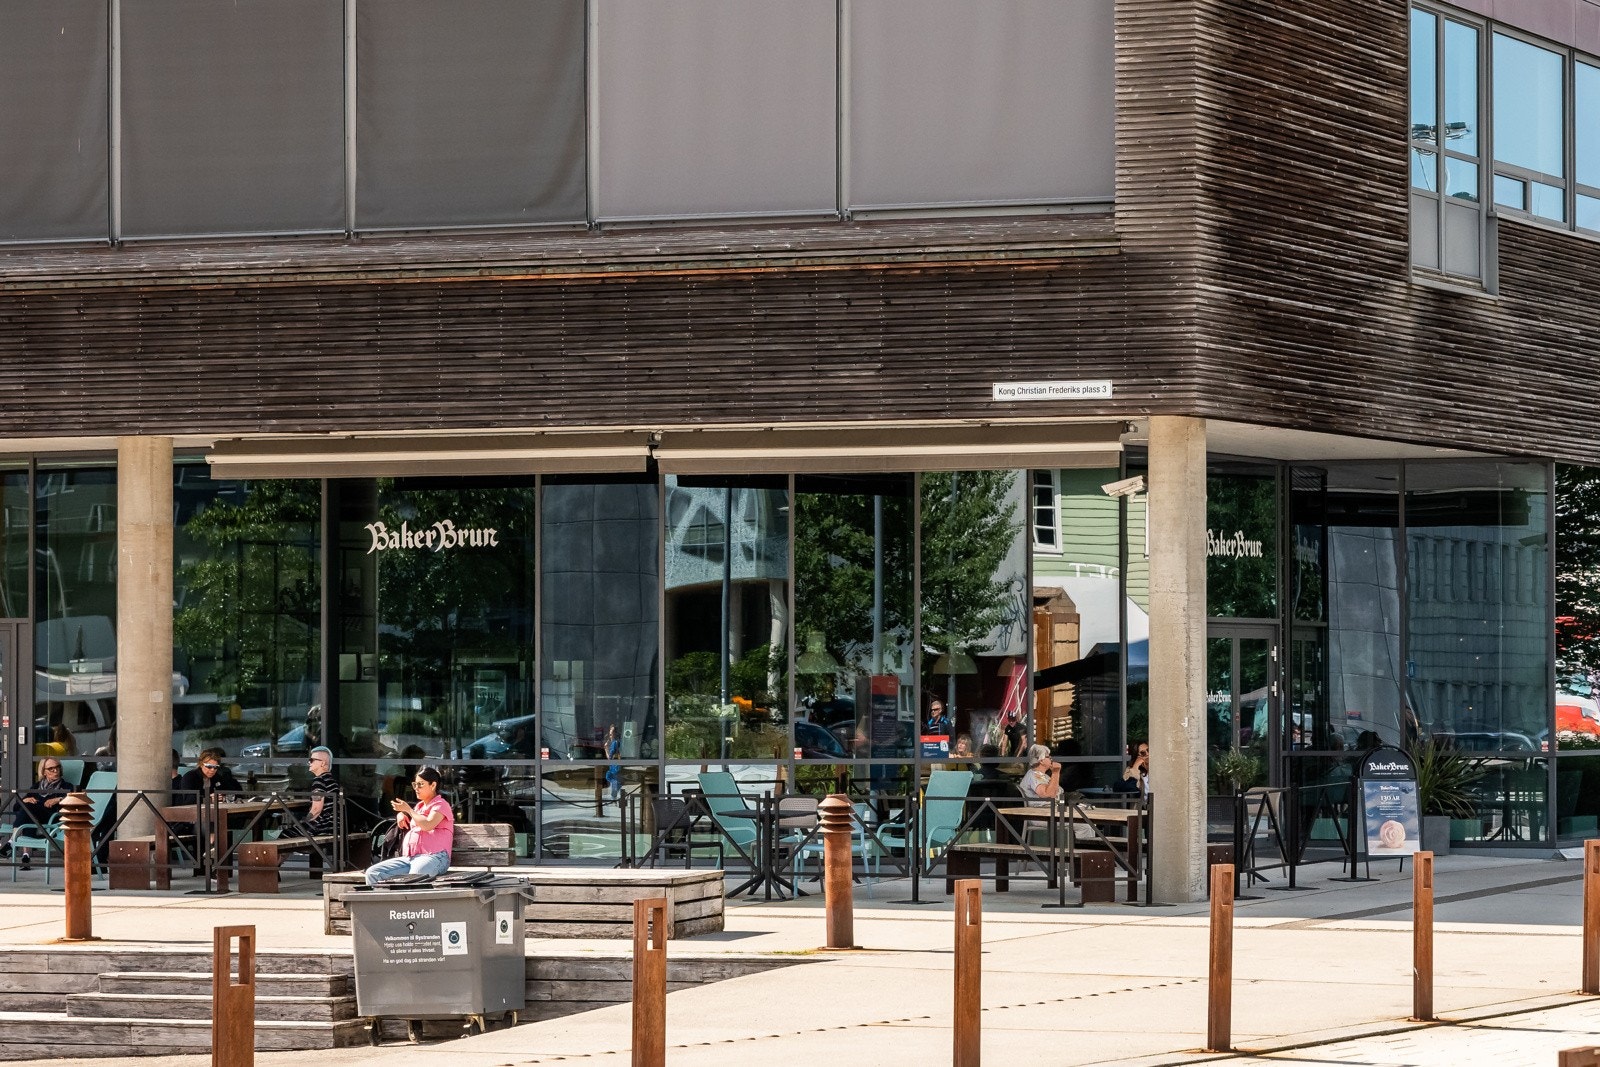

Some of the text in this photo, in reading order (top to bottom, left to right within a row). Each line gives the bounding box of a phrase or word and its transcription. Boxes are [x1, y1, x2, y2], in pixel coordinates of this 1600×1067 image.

[998, 385, 1107, 396] Kong Christian Frederiks plass 3
[1369, 762, 1409, 771] BakerBrun
[389, 909, 435, 920] Restavfall
